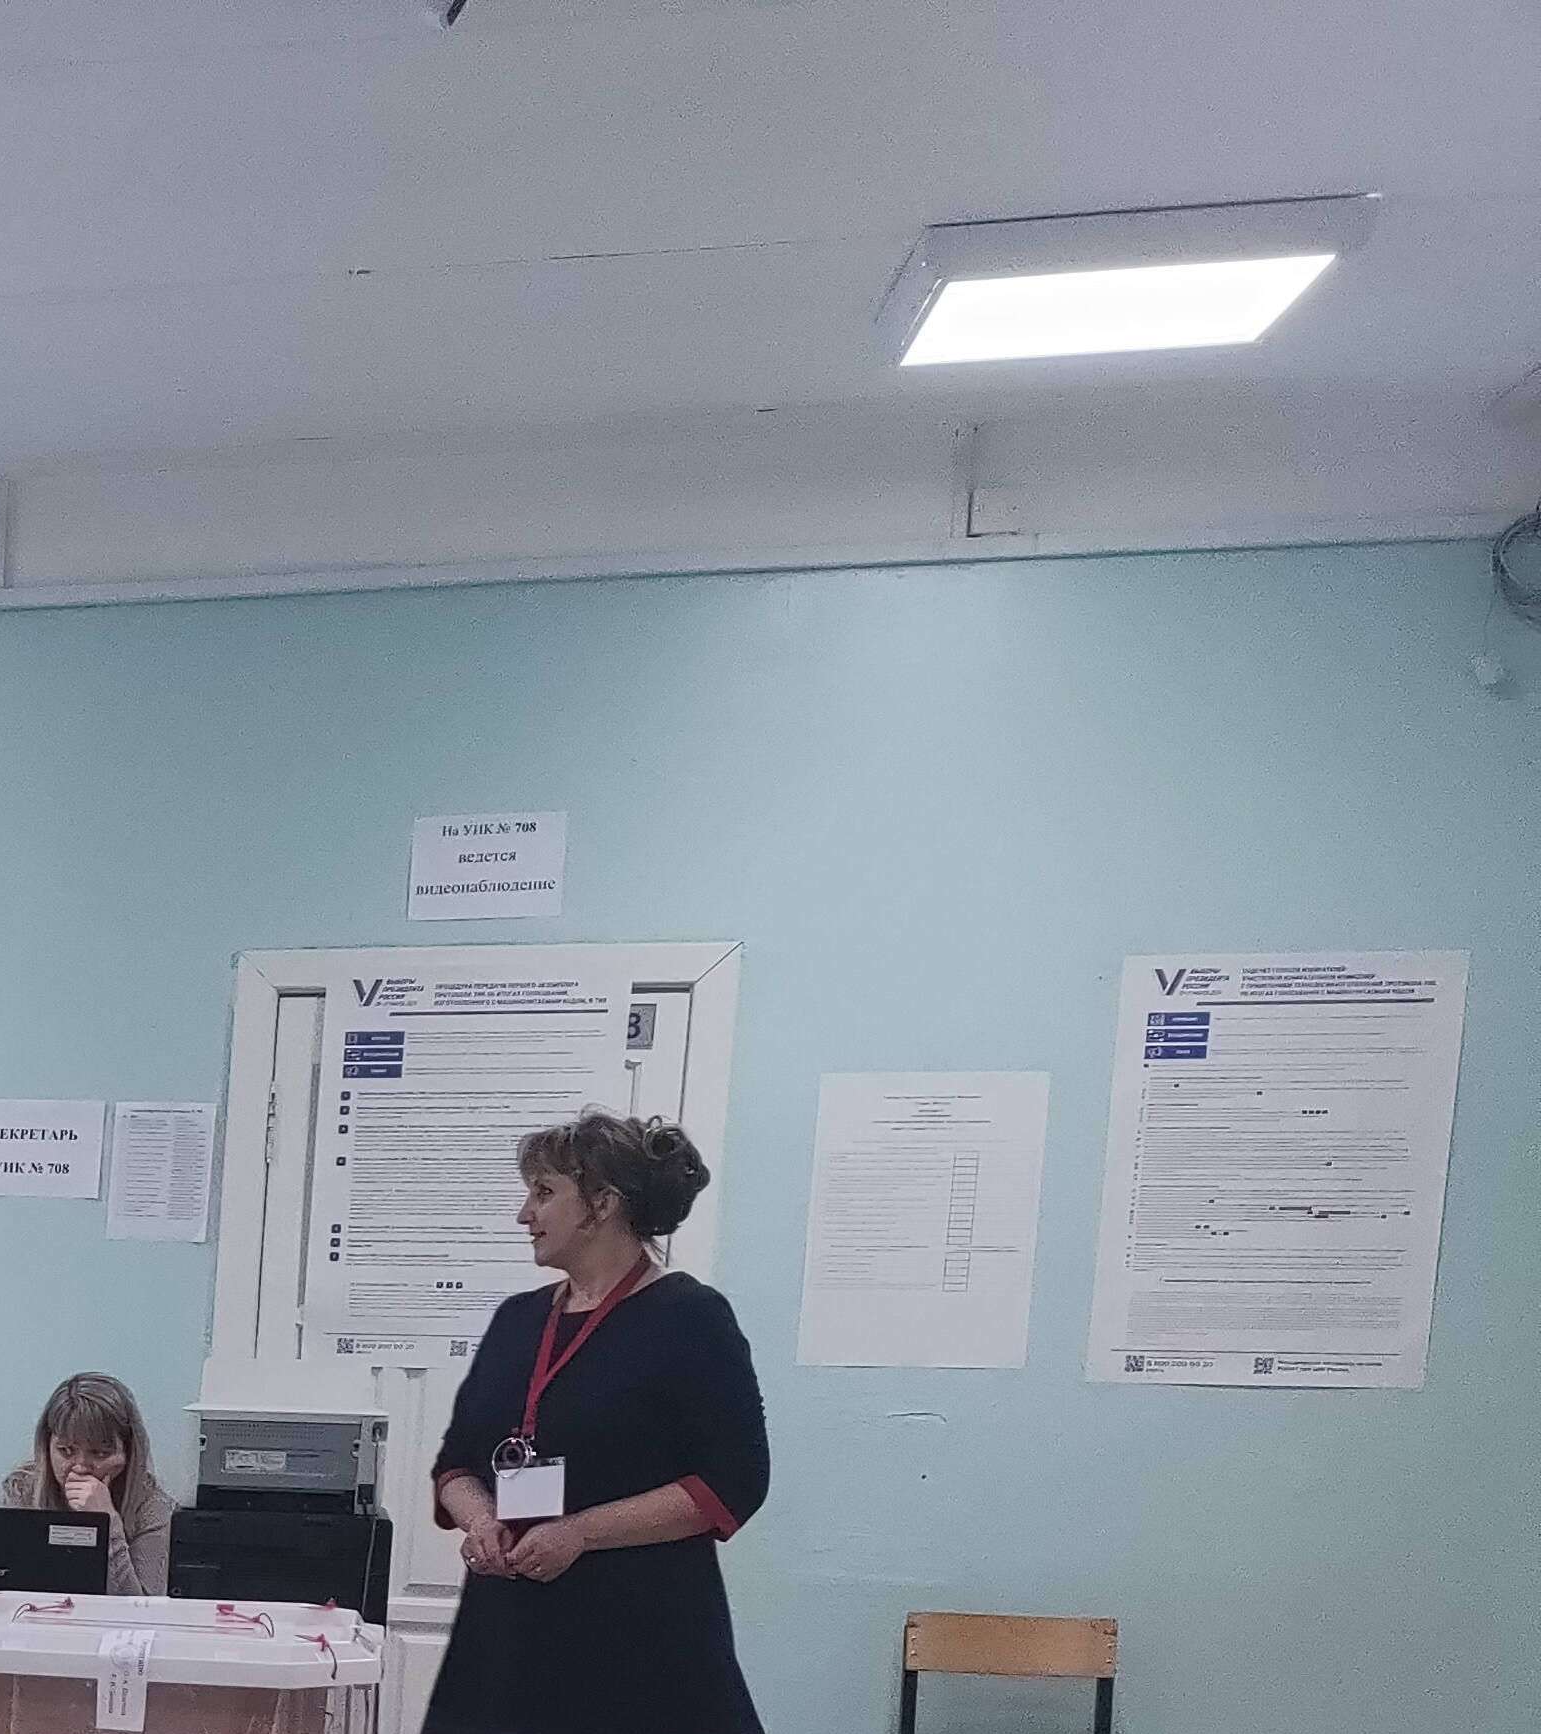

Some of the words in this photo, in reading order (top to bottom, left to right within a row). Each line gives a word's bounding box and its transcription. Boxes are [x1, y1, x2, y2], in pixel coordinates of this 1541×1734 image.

[442, 825, 459, 837] На
[463, 823, 494, 836] УИК
[496, 823, 511, 835] №
[515, 822, 537, 833] 708
[458, 851, 517, 863] ведется
[415, 879, 557, 895] видеонаблюдение
[28, 1162, 44, 1174] №
[47, 1162, 70, 1175] 708
